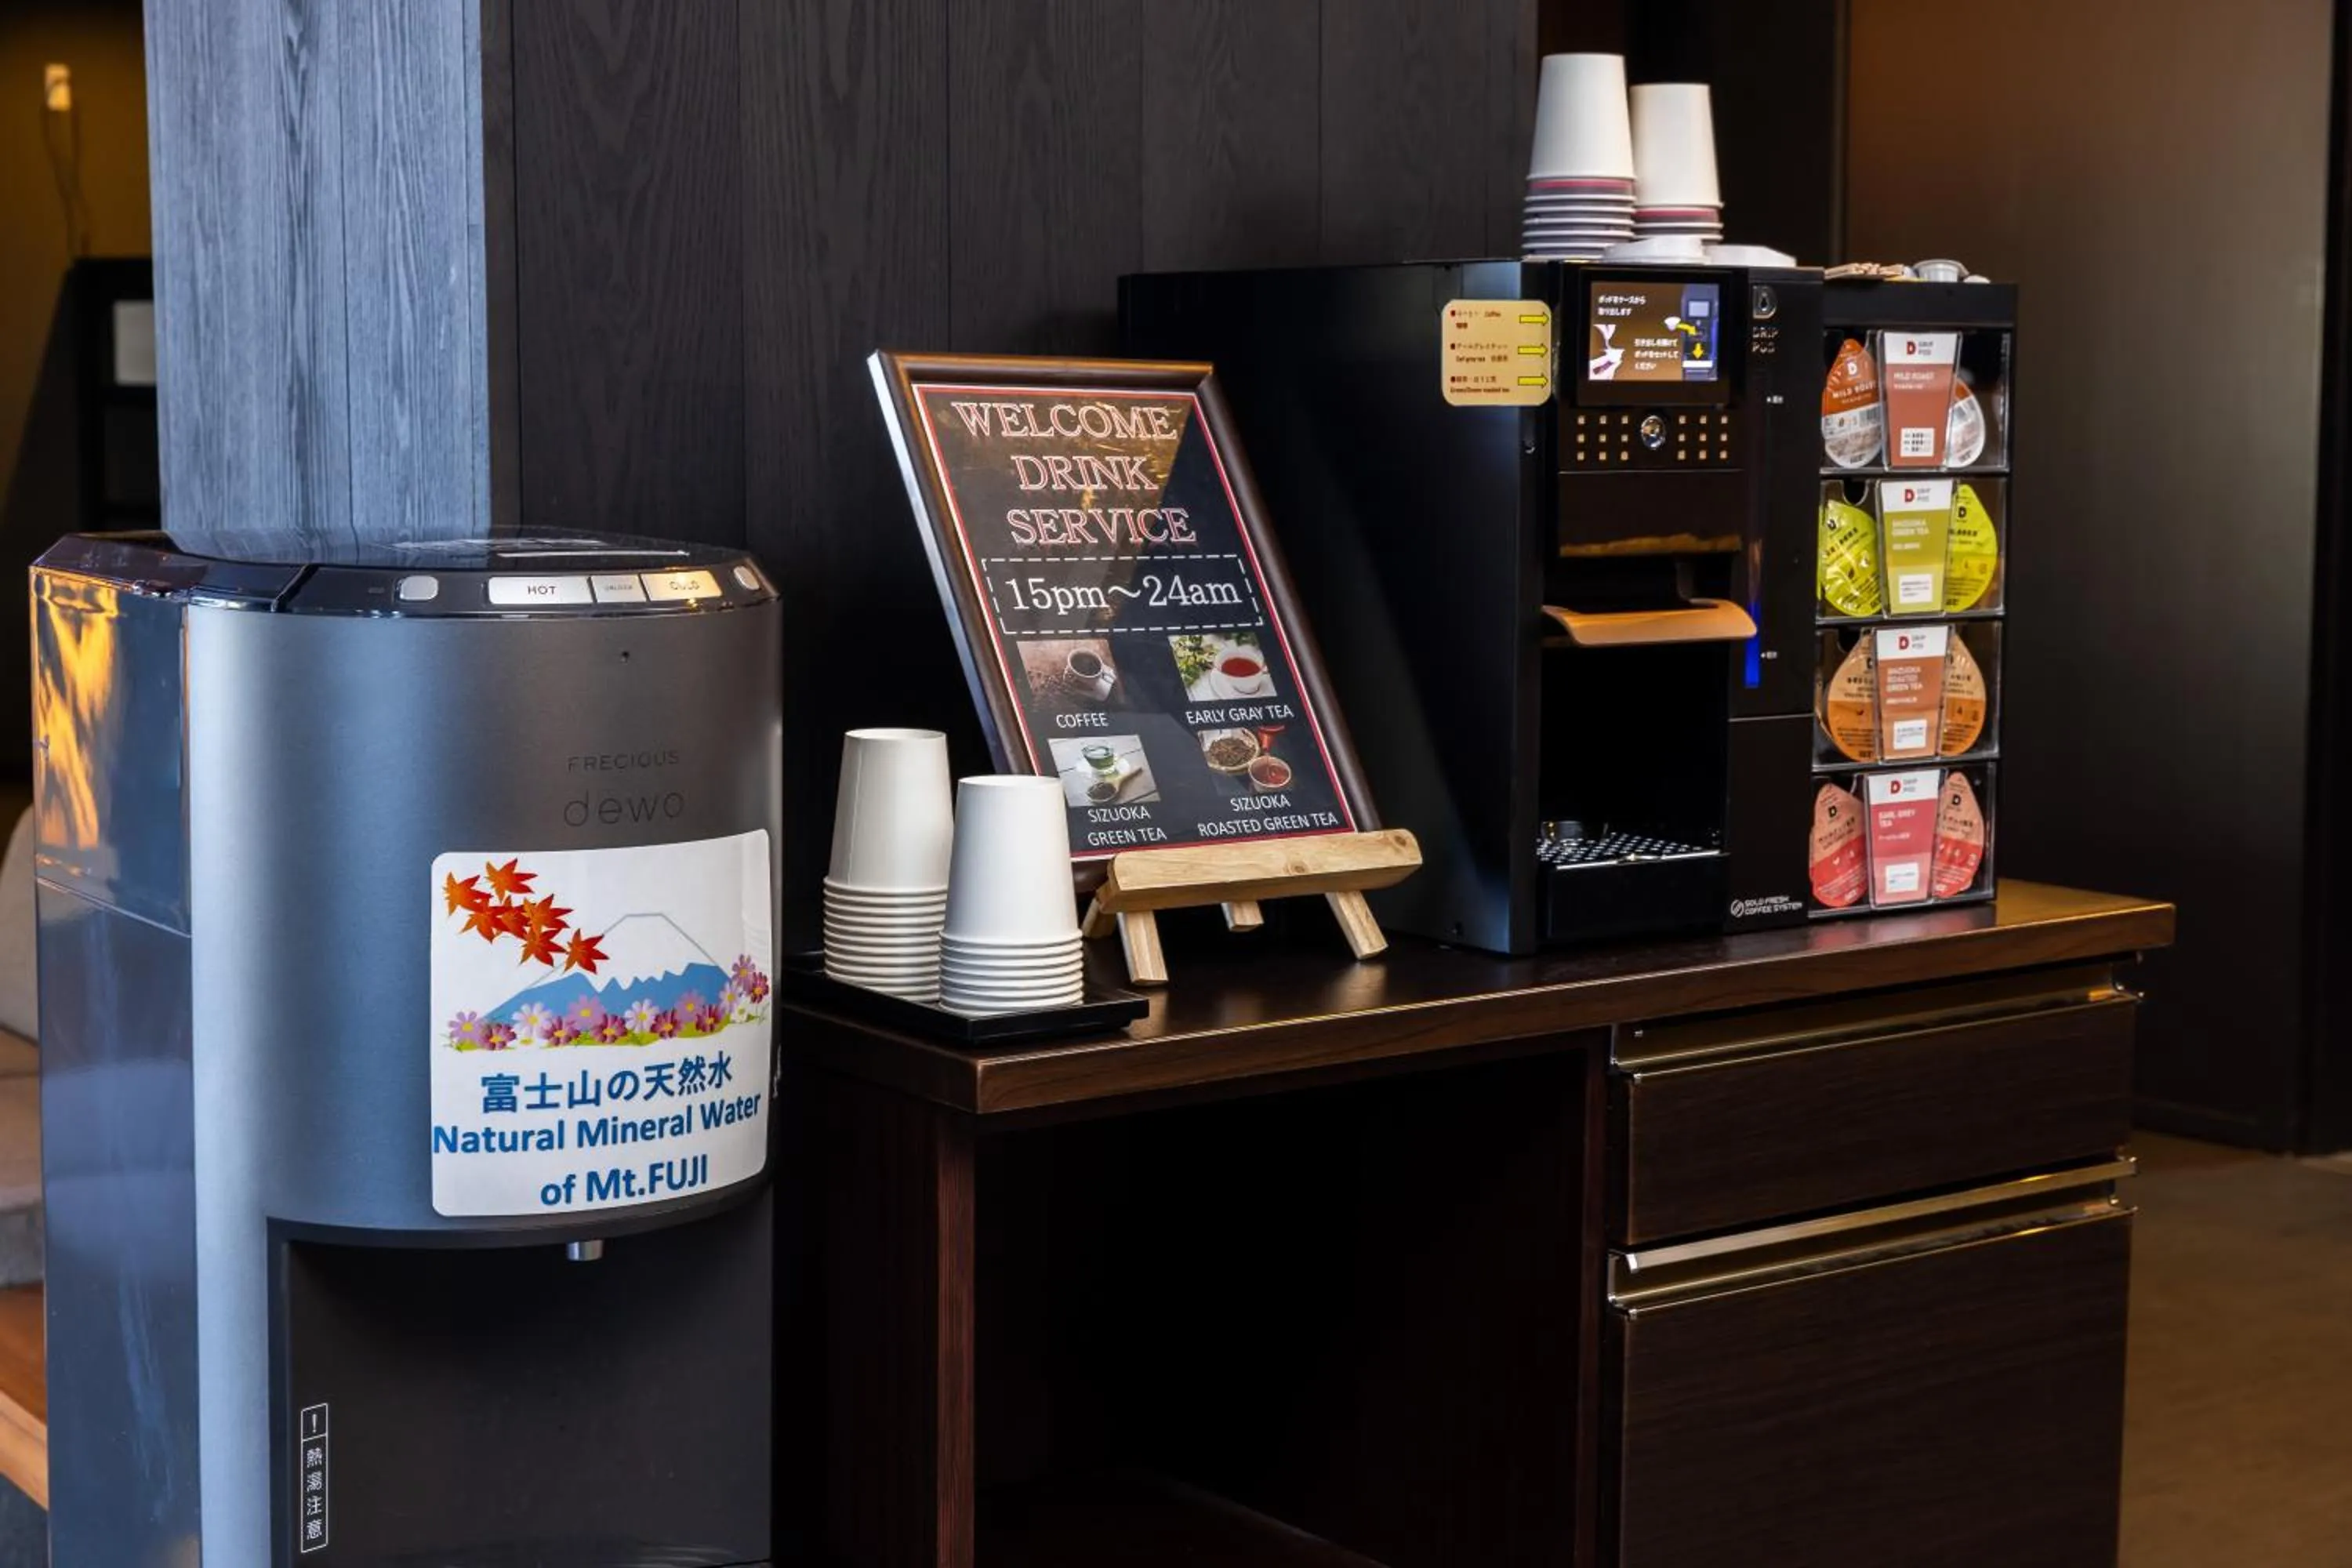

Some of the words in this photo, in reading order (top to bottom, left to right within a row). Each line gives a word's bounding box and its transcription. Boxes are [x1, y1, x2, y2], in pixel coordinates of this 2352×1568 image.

[951, 401, 1178, 441] WELCOME
[1011, 454, 1160, 492] DRINK
[1006, 506, 1197, 545] SERVICE
[527, 584, 557, 596] HOT
[1055, 711, 1109, 729] COFFEE
[1185, 709, 1226, 725] EARLY
[1229, 706, 1264, 723] GRAY
[1265, 703, 1294, 720] TEA
[568, 750, 681, 771] FRECIOUS
[563, 790, 686, 828] dewo
[1087, 806, 1152, 824] SIZUOKA
[1229, 794, 1291, 812] SIZUOKA
[1087, 829, 1136, 848] GREEN
[1138, 827, 1167, 844] TEA
[1197, 818, 1261, 837] ROASTED
[1263, 815, 1310, 833] GREEN
[1310, 811, 1339, 829] TEA
[480, 1050, 733, 1115] 富士山の天然水
[433, 1120, 566, 1155] Natural
[576, 1105, 693, 1149] Mineral
[699, 1093, 761, 1131] Water
[540, 1174, 576, 1207] of
[586, 1153, 709, 1203] Mt.FUJI
[307, 1446, 323, 1541] 熱湯注意
